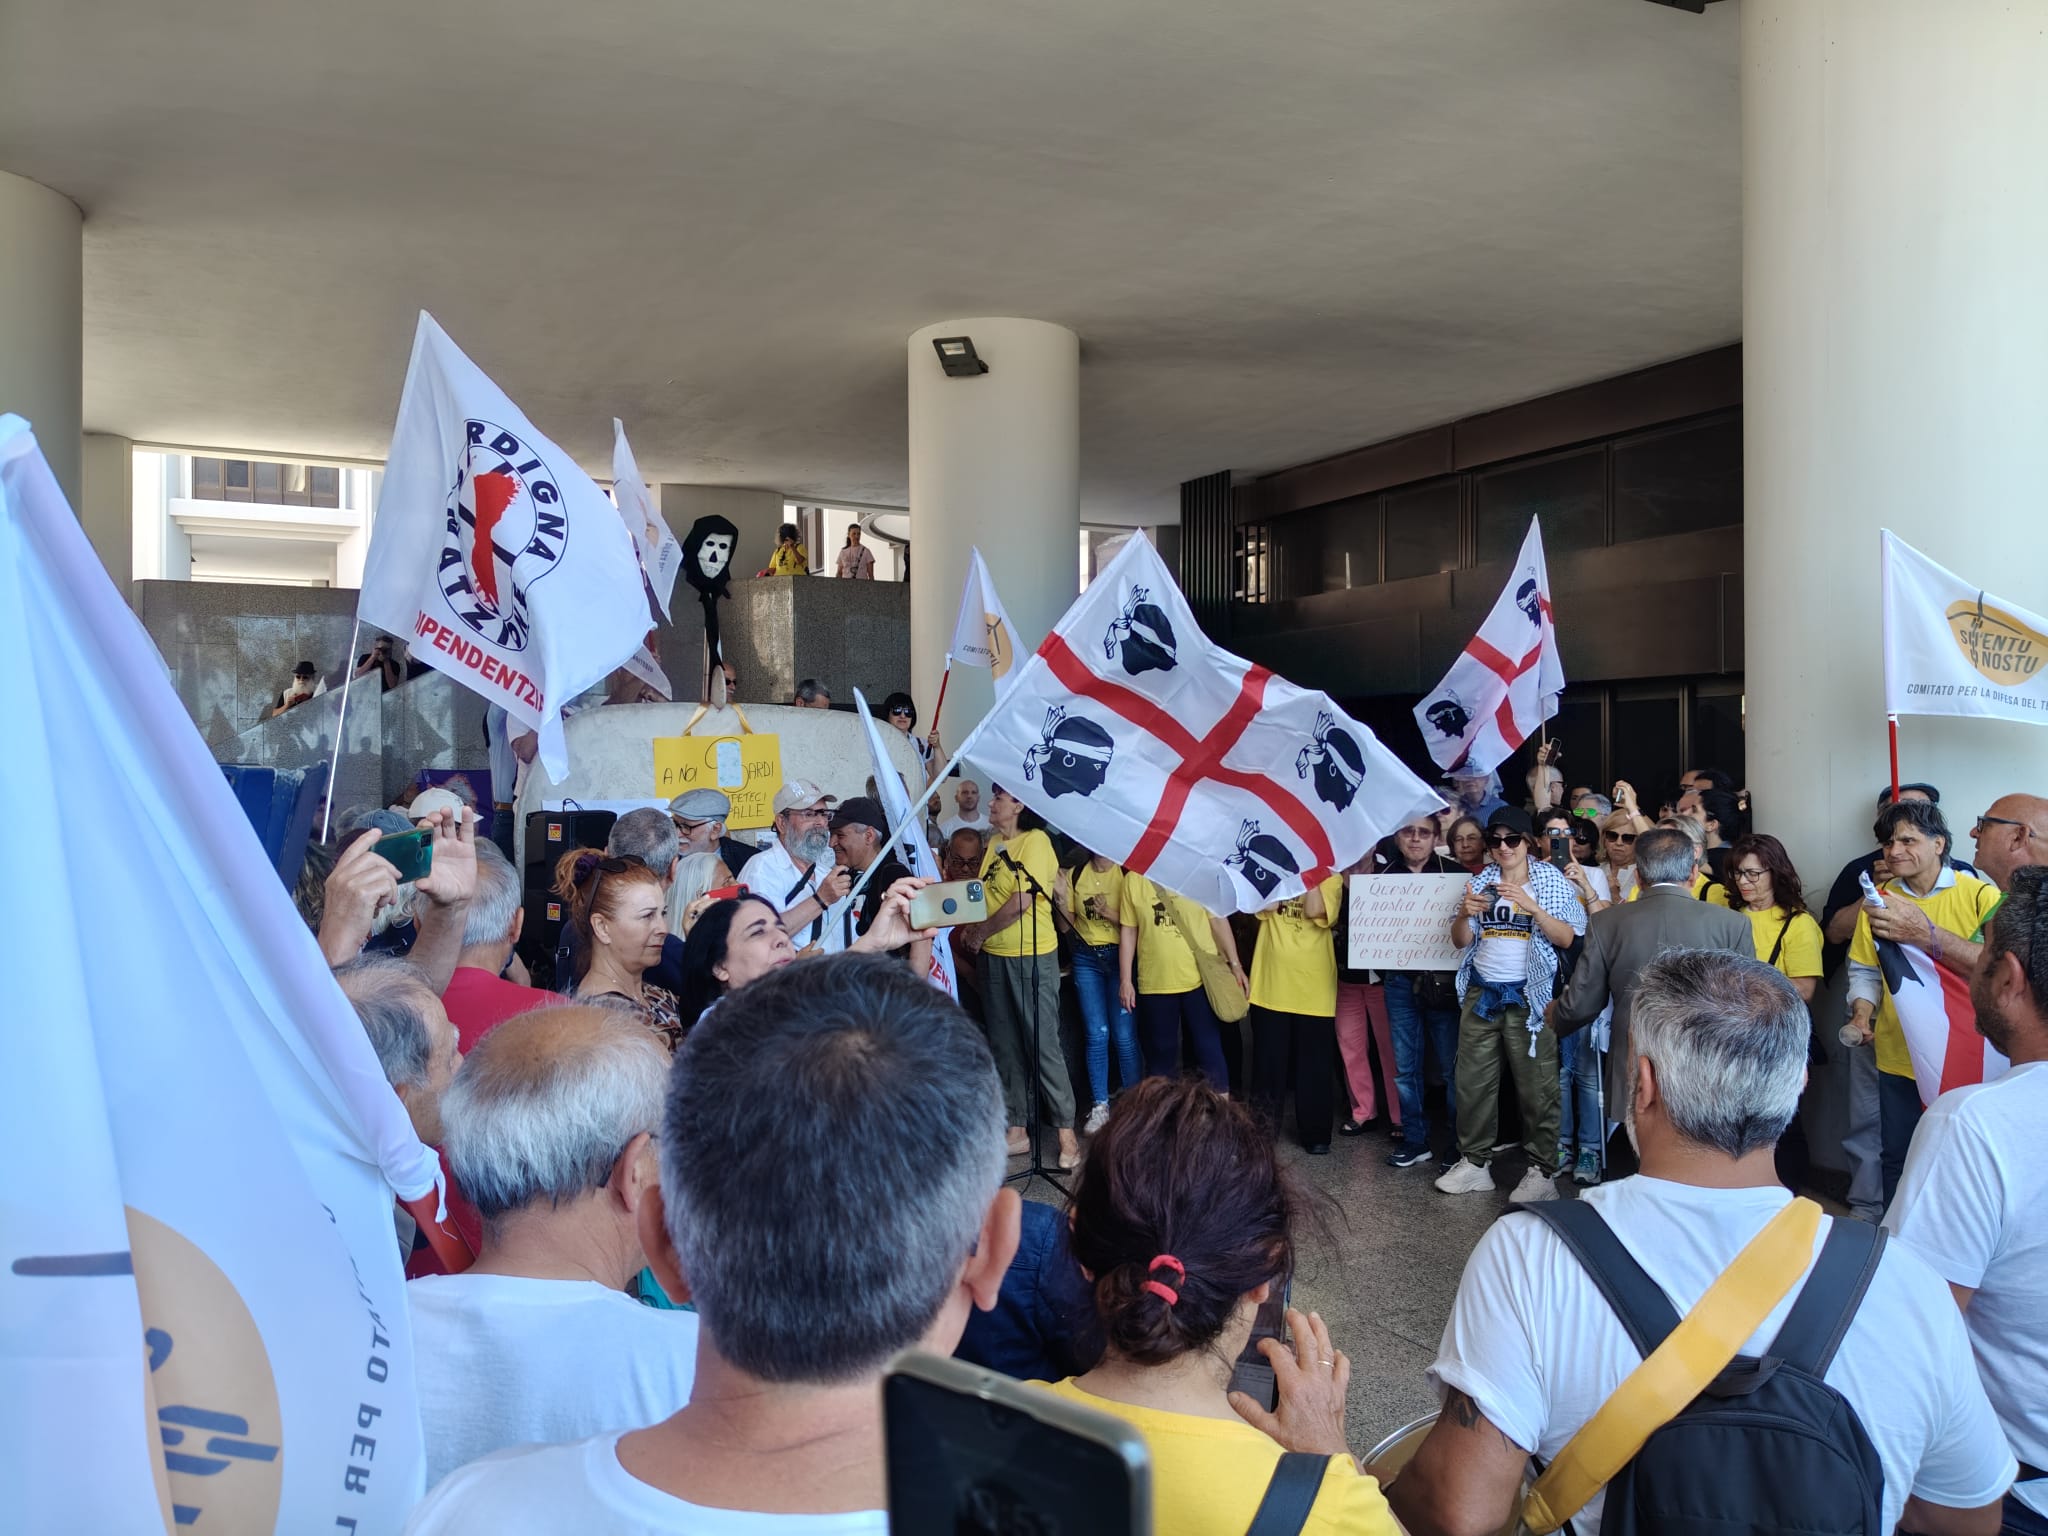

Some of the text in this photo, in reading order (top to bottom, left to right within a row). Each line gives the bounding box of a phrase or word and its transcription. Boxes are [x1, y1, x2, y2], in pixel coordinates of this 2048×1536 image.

[1982, 651, 2039, 674] NOSTU
[1907, 684, 1954, 696] COMITATO
[1957, 685, 1978, 697] PER
[1980, 688, 1991, 698] LA
[1993, 691, 2019, 706] DIFESA
[2022, 697, 2037, 709] DEL
[663, 768, 673, 785] A
[679, 764, 698, 782] NOI
[1369, 881, 1425, 897] Questa
[1351, 896, 1365, 912] la
[1350, 914, 1409, 928] diciamo
[1414, 918, 1432, 928] no
[1352, 929, 1452, 947] speculazion
